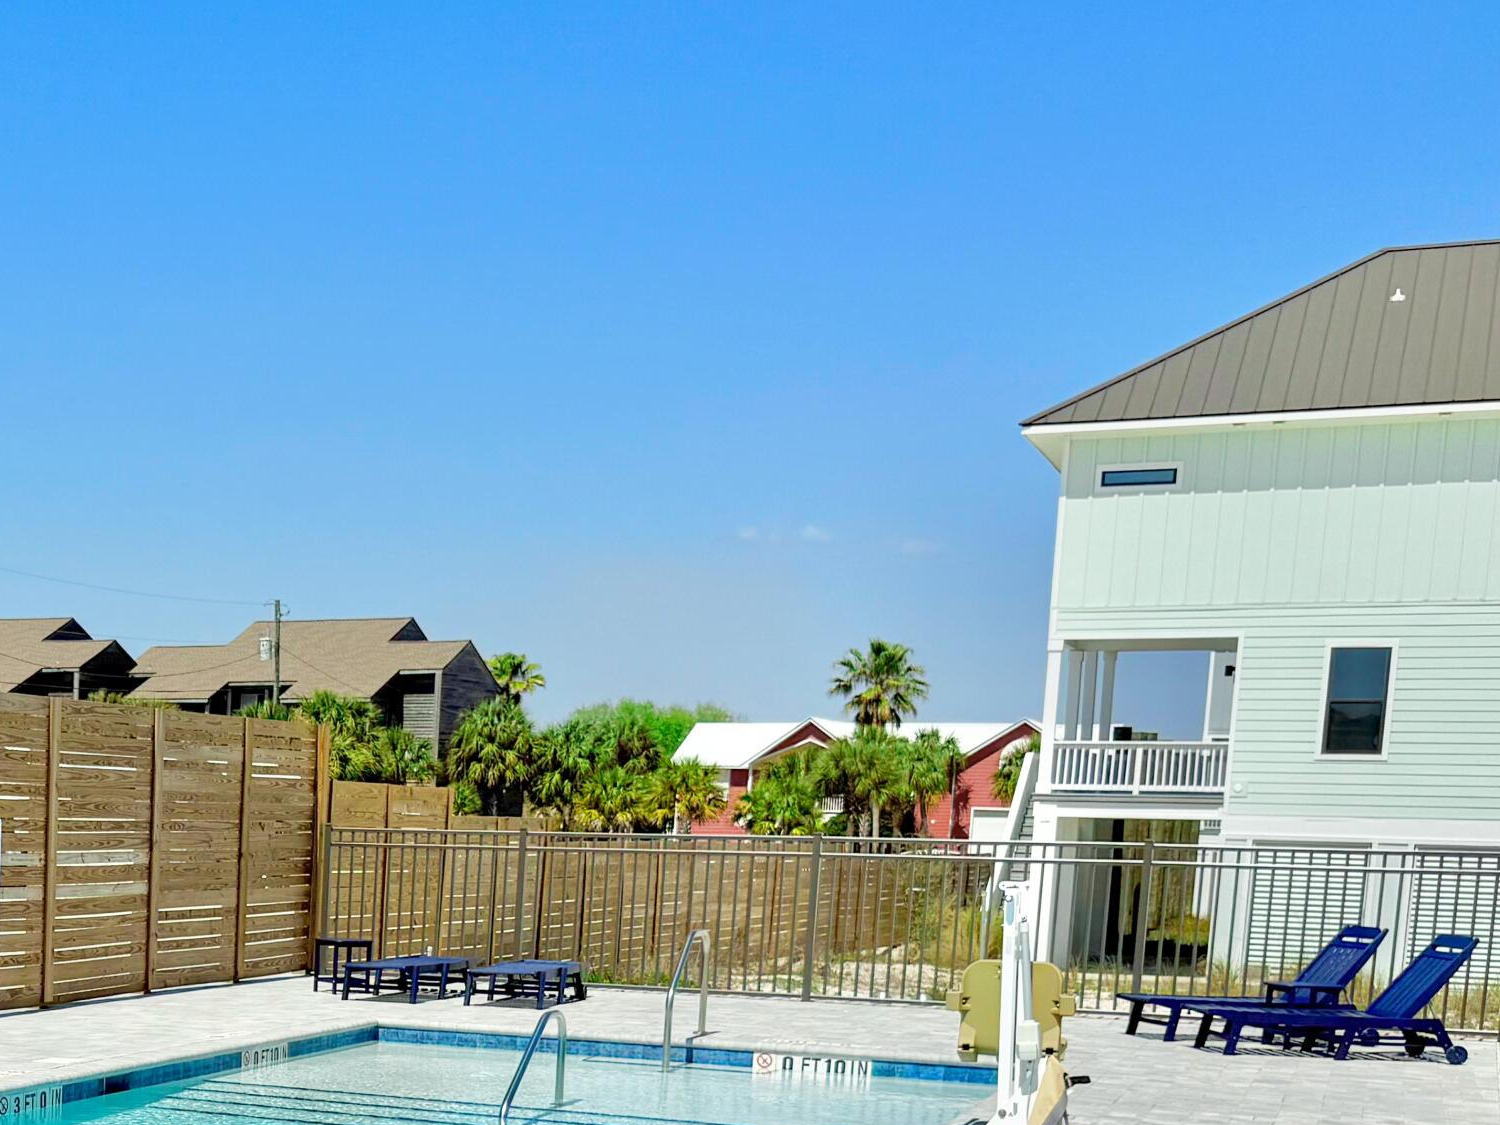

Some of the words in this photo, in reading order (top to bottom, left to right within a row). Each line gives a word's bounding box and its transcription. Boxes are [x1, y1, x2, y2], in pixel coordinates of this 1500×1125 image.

[261, 1049, 270, 1063] FT
[782, 1056, 793, 1071] 0
[801, 1057, 821, 1073] FT
[825, 1058, 846, 1074] 10
[850, 1060, 869, 1076] IN
[13, 1096, 21, 1114] 3
[24, 1094, 36, 1111] FT
[40, 1091, 47, 1108] 0
[51, 1087, 61, 1105] IN
